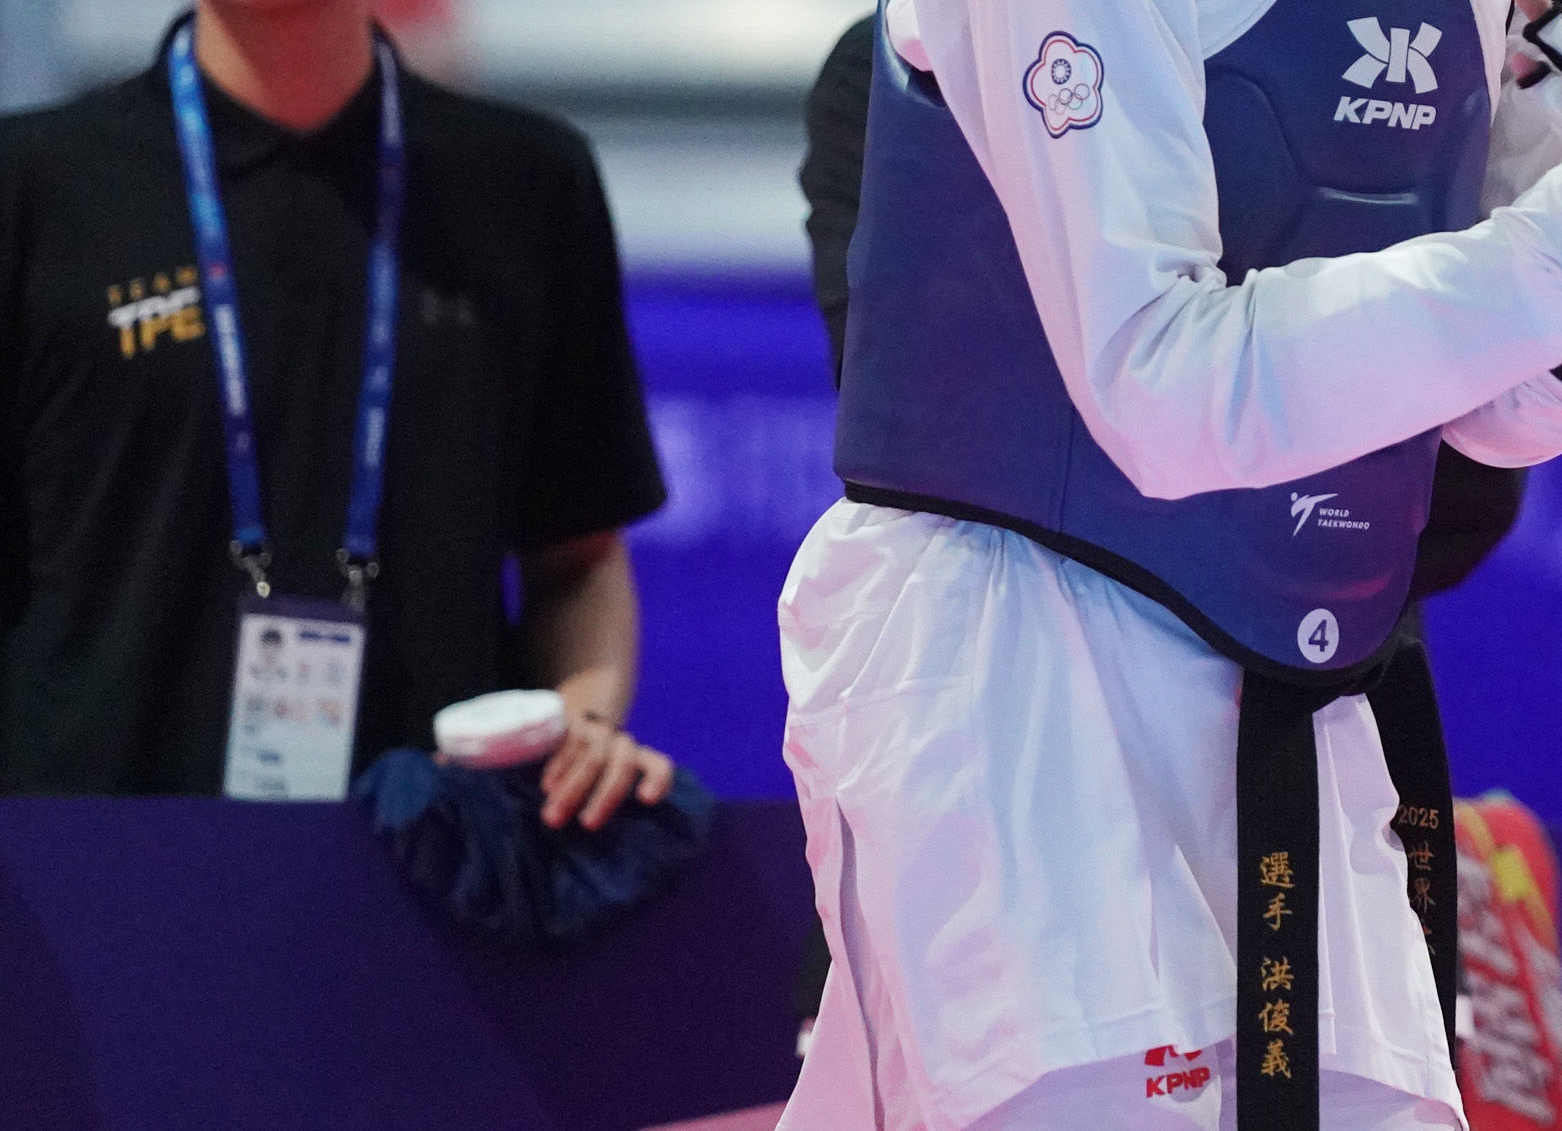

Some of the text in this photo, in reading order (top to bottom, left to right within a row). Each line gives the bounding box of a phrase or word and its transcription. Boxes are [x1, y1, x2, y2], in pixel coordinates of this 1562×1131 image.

[1333, 96, 1437, 130] KPNP
[1317, 519, 1370, 530] TAEKWONDO
[1319, 508, 1350, 517] WORLD
[1308, 619, 1329, 652] 4
[1399, 805, 1439, 829] 2025
[1258, 852, 1295, 1079] 選手 洪俊義
[1146, 1067, 1211, 1098] KPNP
